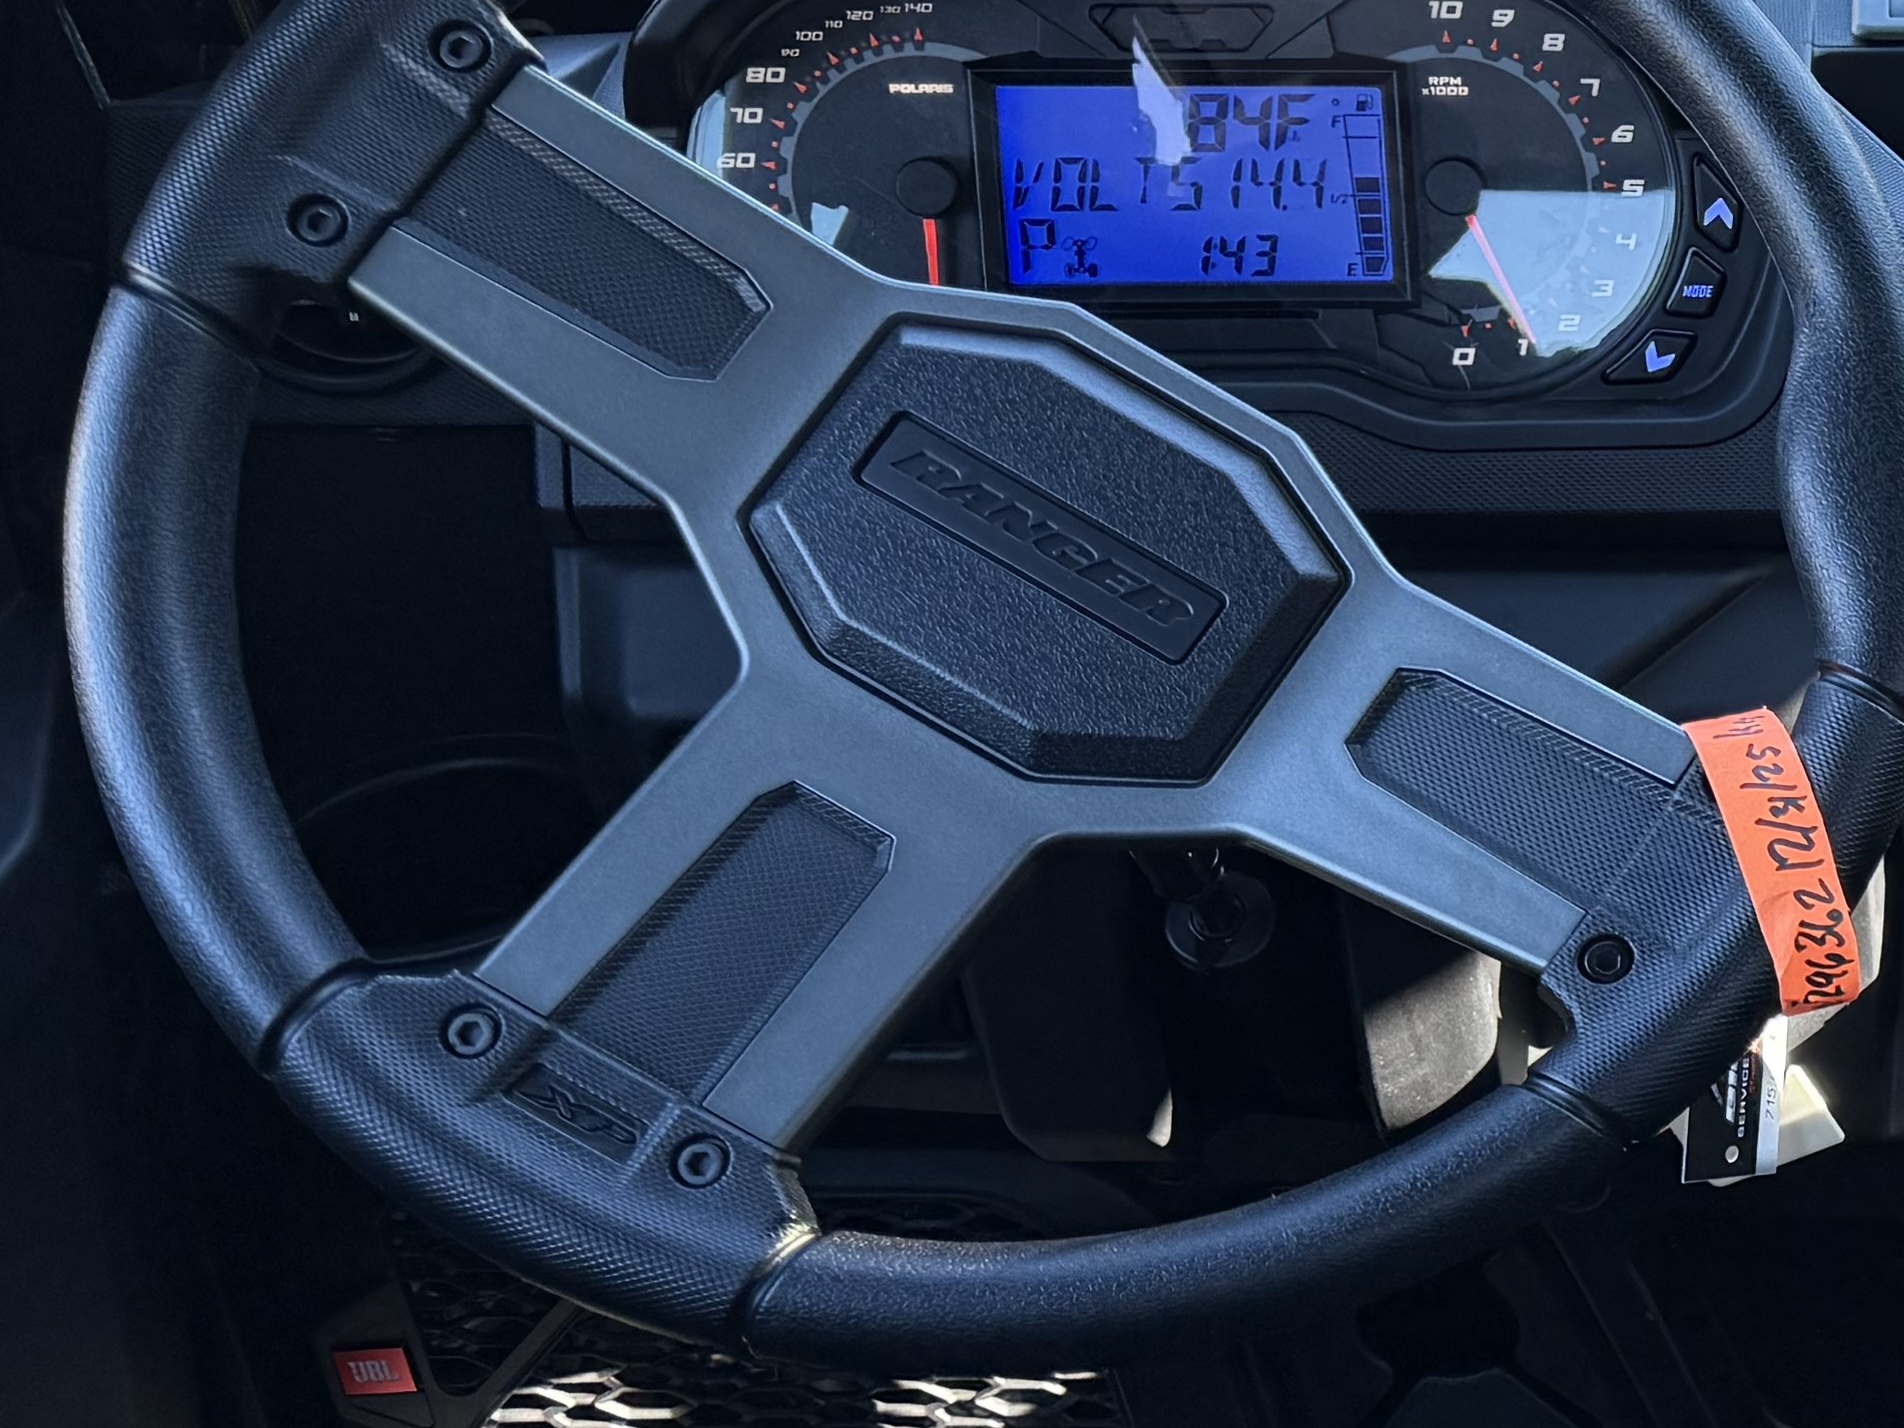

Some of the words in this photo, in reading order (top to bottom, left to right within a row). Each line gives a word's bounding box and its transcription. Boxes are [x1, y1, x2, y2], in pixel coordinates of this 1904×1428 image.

[846, 10, 874, 21] 120
[880, 5, 901, 14] 130
[904, 2, 933, 13] 140
[1428, 0, 1464, 20] 10
[825, 20, 843, 29] 110
[1491, 9, 1515, 27] 9
[795, 31, 824, 42] 100
[1542, 33, 1565, 52] 8
[781, 49, 800, 58] 90
[745, 67, 786, 84] 80
[1428, 76, 1462, 86] RPM
[888, 83, 955, 95] POLARIS
[1580, 78, 1601, 97] 7
[730, 107, 763, 124] 70
[1611, 124, 1635, 143] 6
[716, 152, 756, 169] 60
[1620, 179, 1645, 197] 5
[1019, 218, 1056, 275] P
[1615, 233, 1638, 250] 4
[1591, 279, 1615, 297] 3
[1682, 285, 1714, 297] MODE
[1558, 314, 1581, 332] 2
[1517, 338, 1529, 356] 1
[1452, 347, 1476, 365] 0
[889, 448, 1196, 627] RANGER
[1737, 1057, 1750, 1138] SERVICE
